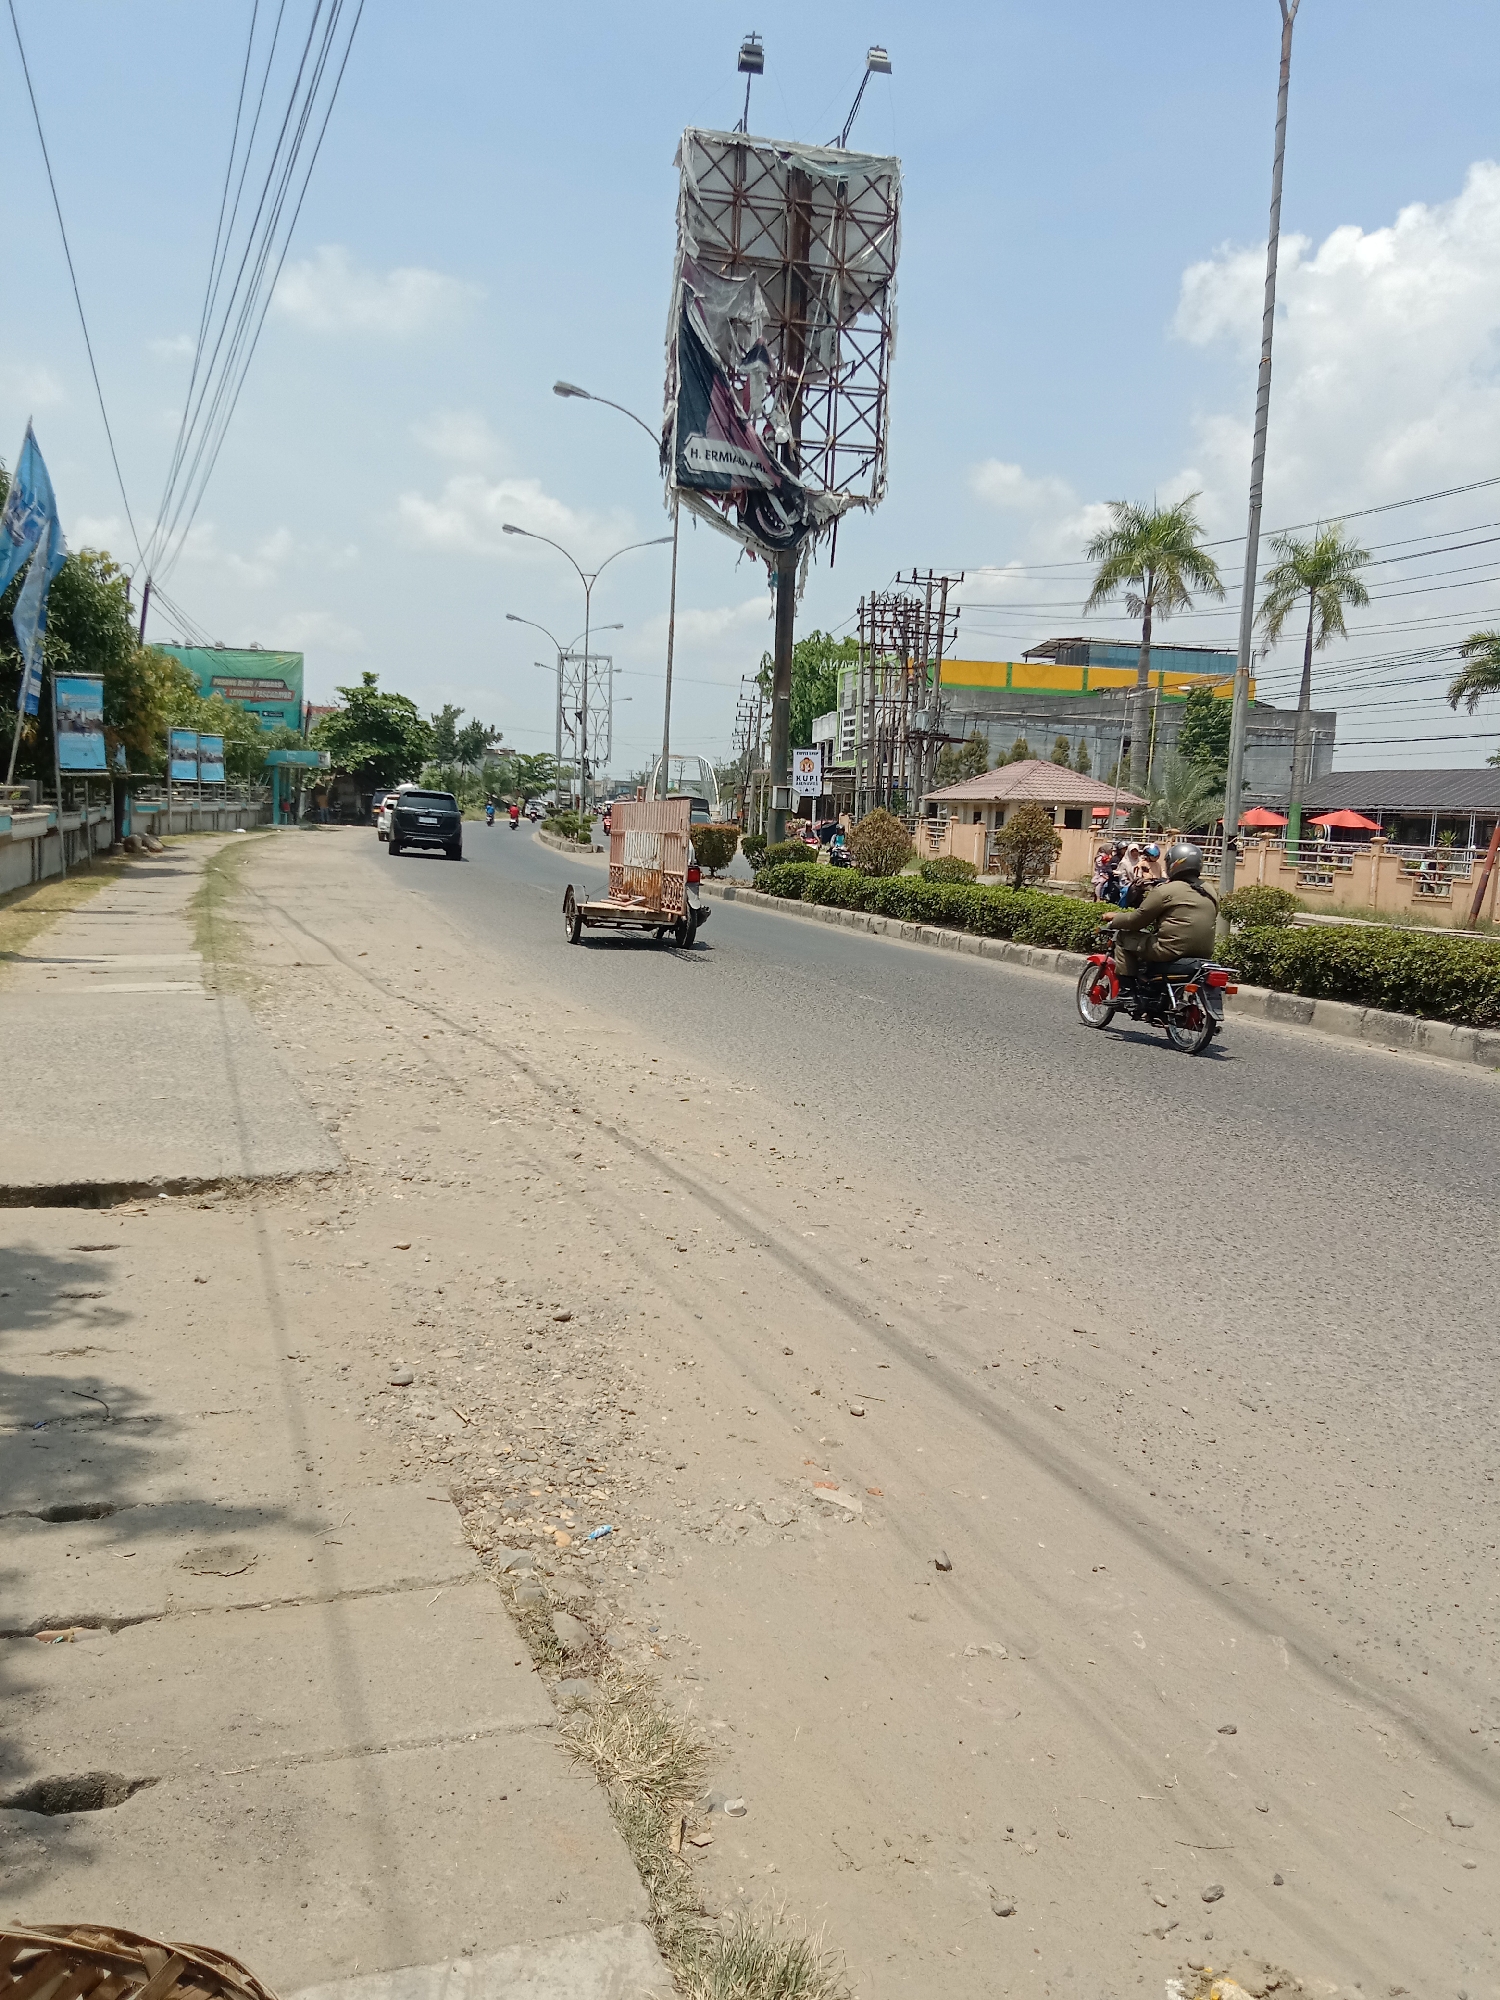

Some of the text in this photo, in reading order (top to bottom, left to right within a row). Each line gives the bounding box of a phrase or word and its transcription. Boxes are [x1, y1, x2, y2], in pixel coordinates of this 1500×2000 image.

[691, 448, 701, 460] H.
[229, 689, 292, 700] LAYANAN PASCABAYAR
